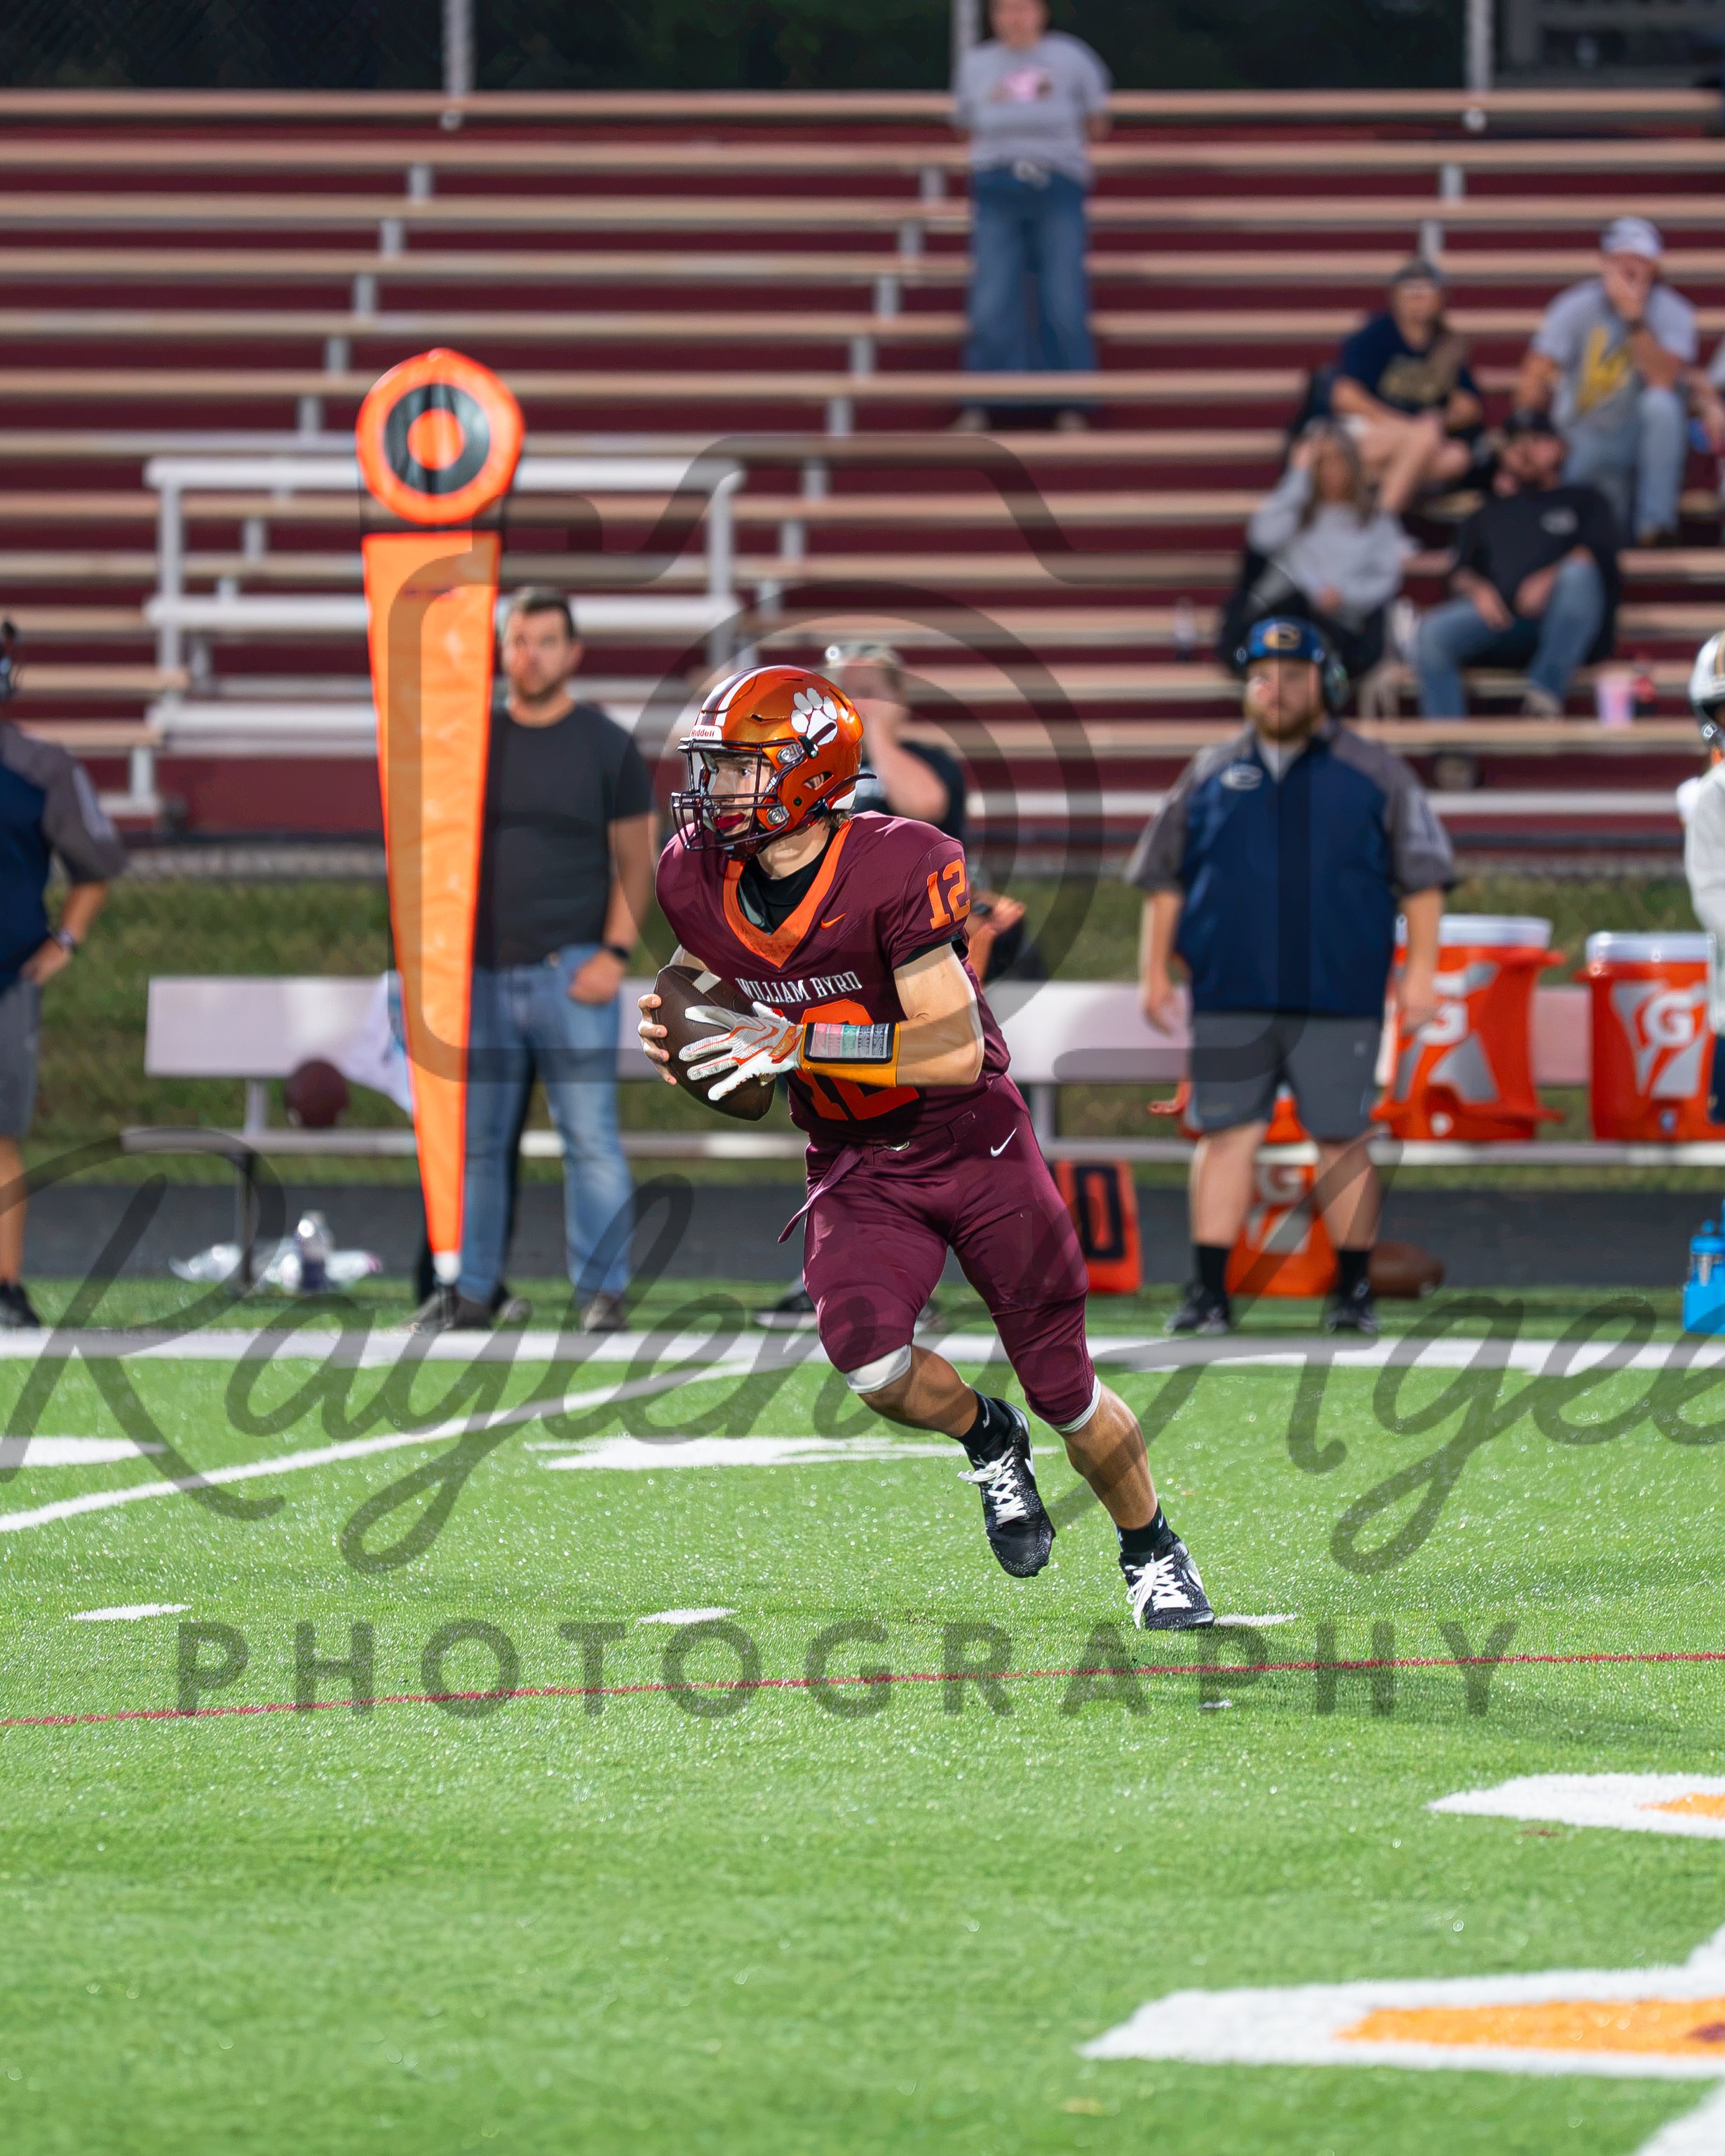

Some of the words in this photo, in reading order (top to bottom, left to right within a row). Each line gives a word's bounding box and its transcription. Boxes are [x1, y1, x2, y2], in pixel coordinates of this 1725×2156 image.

[926, 858, 970, 930] 12
[734, 977, 811, 1004] WILLIAM
[809, 970, 863, 998] BYRD
[1641, 991, 1695, 1048] G
[1048, 1165, 1125, 1260] 0
